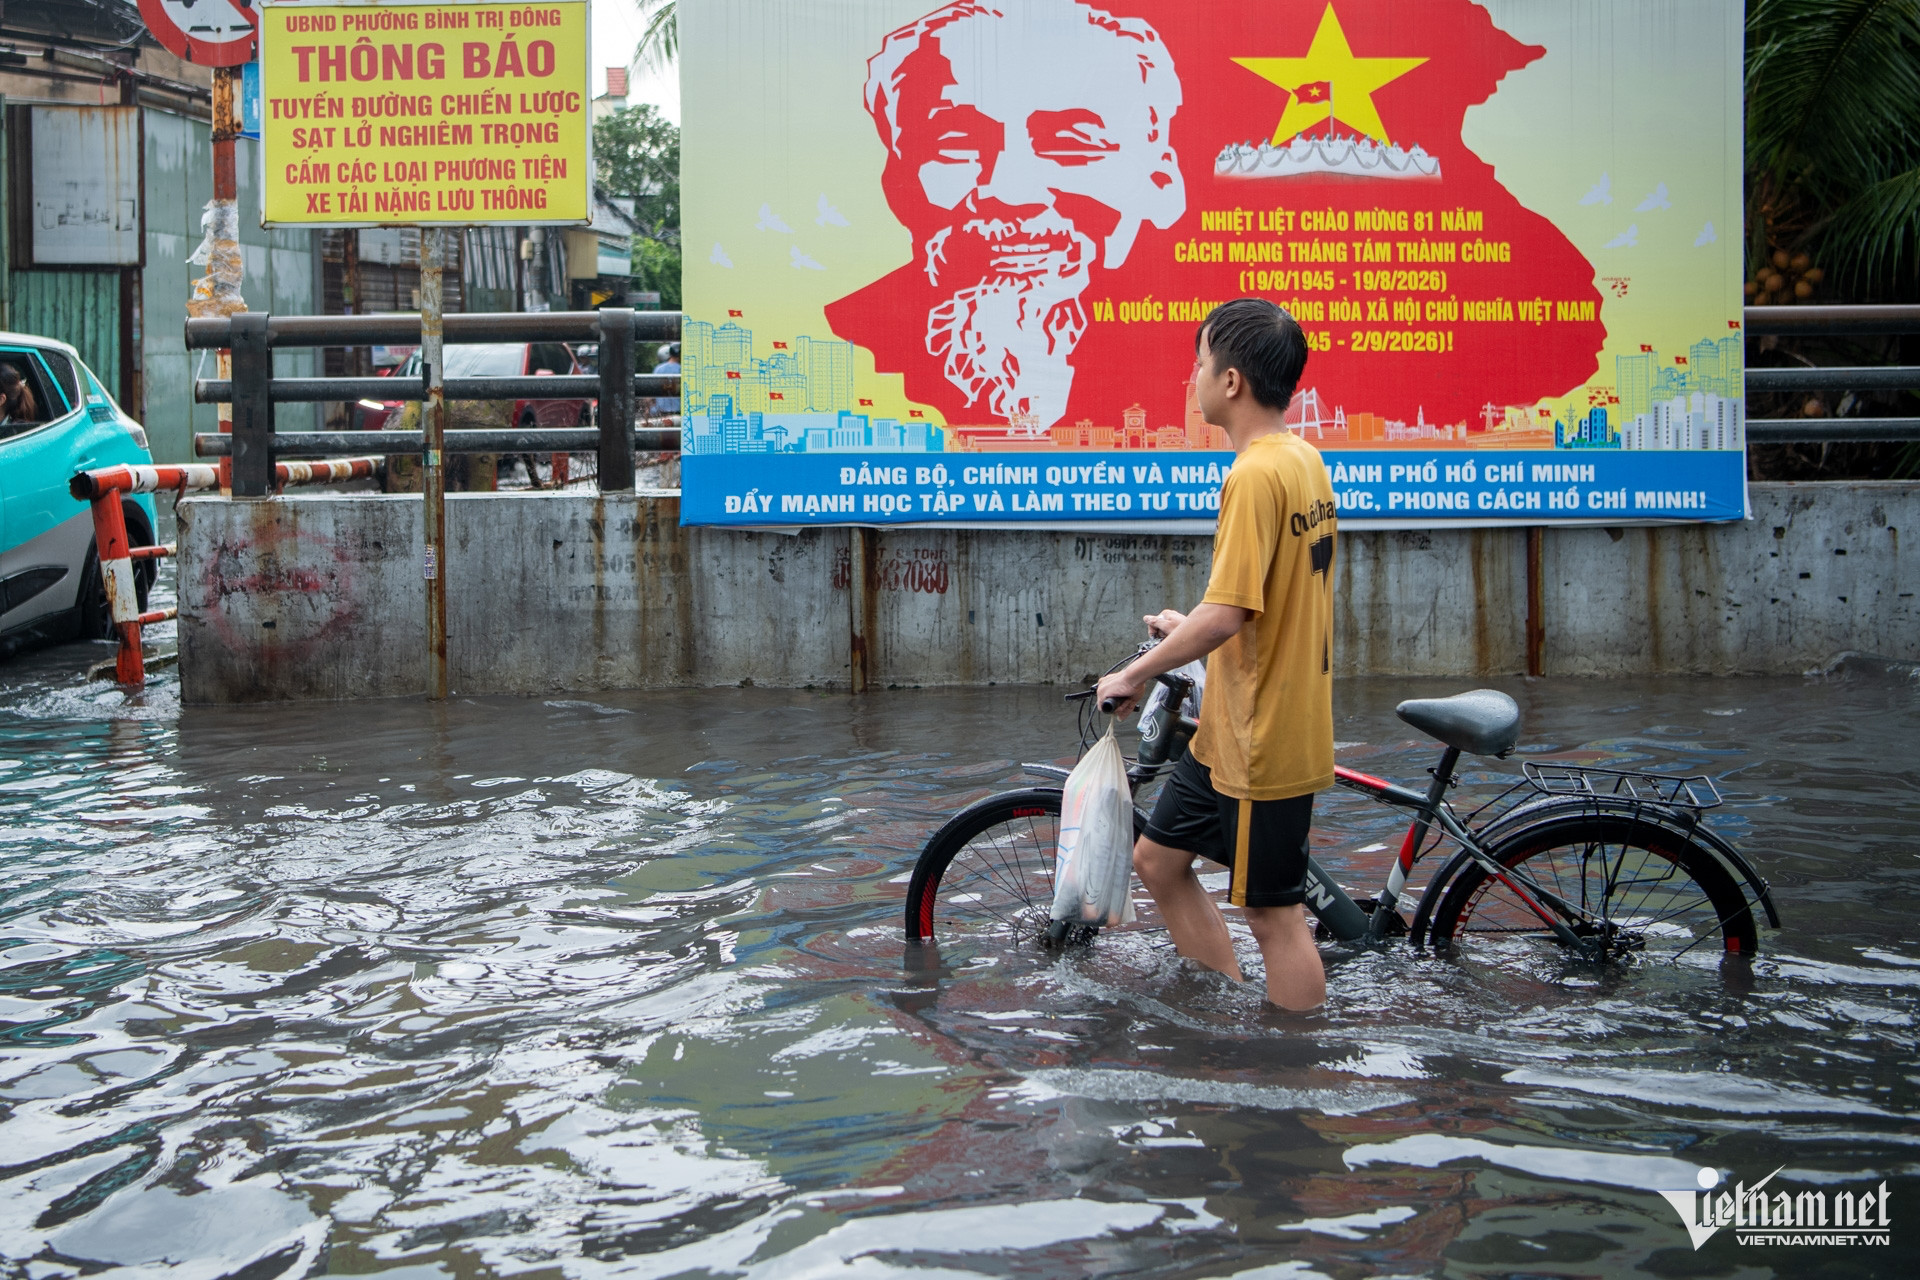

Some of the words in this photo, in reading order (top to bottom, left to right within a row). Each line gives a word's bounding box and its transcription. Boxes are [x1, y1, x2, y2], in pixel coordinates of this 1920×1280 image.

[287, 15, 336, 32] UBND
[343, 11, 418, 31] PHƯỜNG
[425, 8, 469, 29] BÌNH
[475, 10, 503, 31] TRỊ
[510, 6, 560, 26] ĐÔNG
[292, 36, 444, 82] THÔNG
[463, 32, 555, 78] BÁO
[270, 90, 343, 118] TUYẾN
[352, 91, 432, 117] ĐƯỜNG
[441, 87, 511, 115] CHIẾN
[521, 90, 579, 117] LƯỢC
[293, 127, 336, 152] SẠT
[345, 119, 372, 147] LỞ
[380, 120, 472, 146] NGHIÊM
[481, 122, 558, 148] TRỌNG
[286, 159, 329, 184] CẤM
[338, 158, 376, 183] CÁC
[384, 161, 426, 186] LOẠI
[435, 157, 515, 181] PHƯƠNG
[523, 153, 566, 183] TIỆN
[307, 192, 330, 213] XE
[338, 185, 367, 212] TẢI
[375, 187, 430, 216] NẶNG
[438, 188, 474, 210] LƯU
[481, 184, 546, 209] THÔNG
[1202, 206, 1253, 235] NHIỆT
[1259, 206, 1295, 235] LIỆT
[1301, 207, 1348, 231] CHÀO
[1355, 207, 1408, 231] MỪNG
[1414, 211, 1432, 231] 81
[1441, 207, 1482, 231] NĂM
[1175, 238, 1223, 262] CÁCH
[1229, 241, 1282, 266] MẠNG
[1288, 238, 1347, 262] THÁNG
[1353, 238, 1391, 262] TÁM
[1397, 238, 1455, 262] THÀNH
[1462, 238, 1510, 262] CÔNG
[1240, 270, 1334, 292] (19/8/1945
[1353, 270, 1446, 292] 19/8/2026)
[1093, 297, 1114, 321] VÀ
[1120, 294, 1163, 323] QUỐC
[1329, 297, 1362, 321] HÒA
[1367, 297, 1388, 321] XÃ
[1394, 297, 1420, 325] HỘI
[1426, 295, 1458, 321] CHỦ
[1464, 297, 1513, 321] NGHĨA
[1518, 297, 1552, 325] VIỆT
[1557, 301, 1594, 320] NAM
[1352, 330, 1452, 352] 2/9/2026)!
[840, 461, 906, 484] ĐẢNG
[916, 463, 954, 488] BỘ,
[964, 463, 1037, 484] CHÍNH
[1046, 460, 1124, 486] QUYỀN
[1133, 462, 1163, 483] VÀ
[1391, 459, 1437, 482] PHỐ
[1446, 459, 1476, 482] HỒ
[1485, 461, 1523, 482] CHÍ
[1533, 464, 1594, 481] MINH
[725, 488, 773, 512] ĐẨY
[782, 494, 854, 516] MẠNH
[863, 494, 912, 515] HỌC
[919, 490, 966, 516] TẬP
[973, 490, 1004, 511] VÀ
[1012, 489, 1063, 511] LÀM
[1072, 493, 1131, 510] THEO
[1139, 491, 1170, 510] TƯ
[1389, 491, 1469, 509] PHONG
[1478, 488, 1540, 509] CÁCH
[1549, 486, 1579, 508] HỒ
[1589, 487, 1626, 508] CHÍ
[1636, 491, 1705, 508] MINH!
